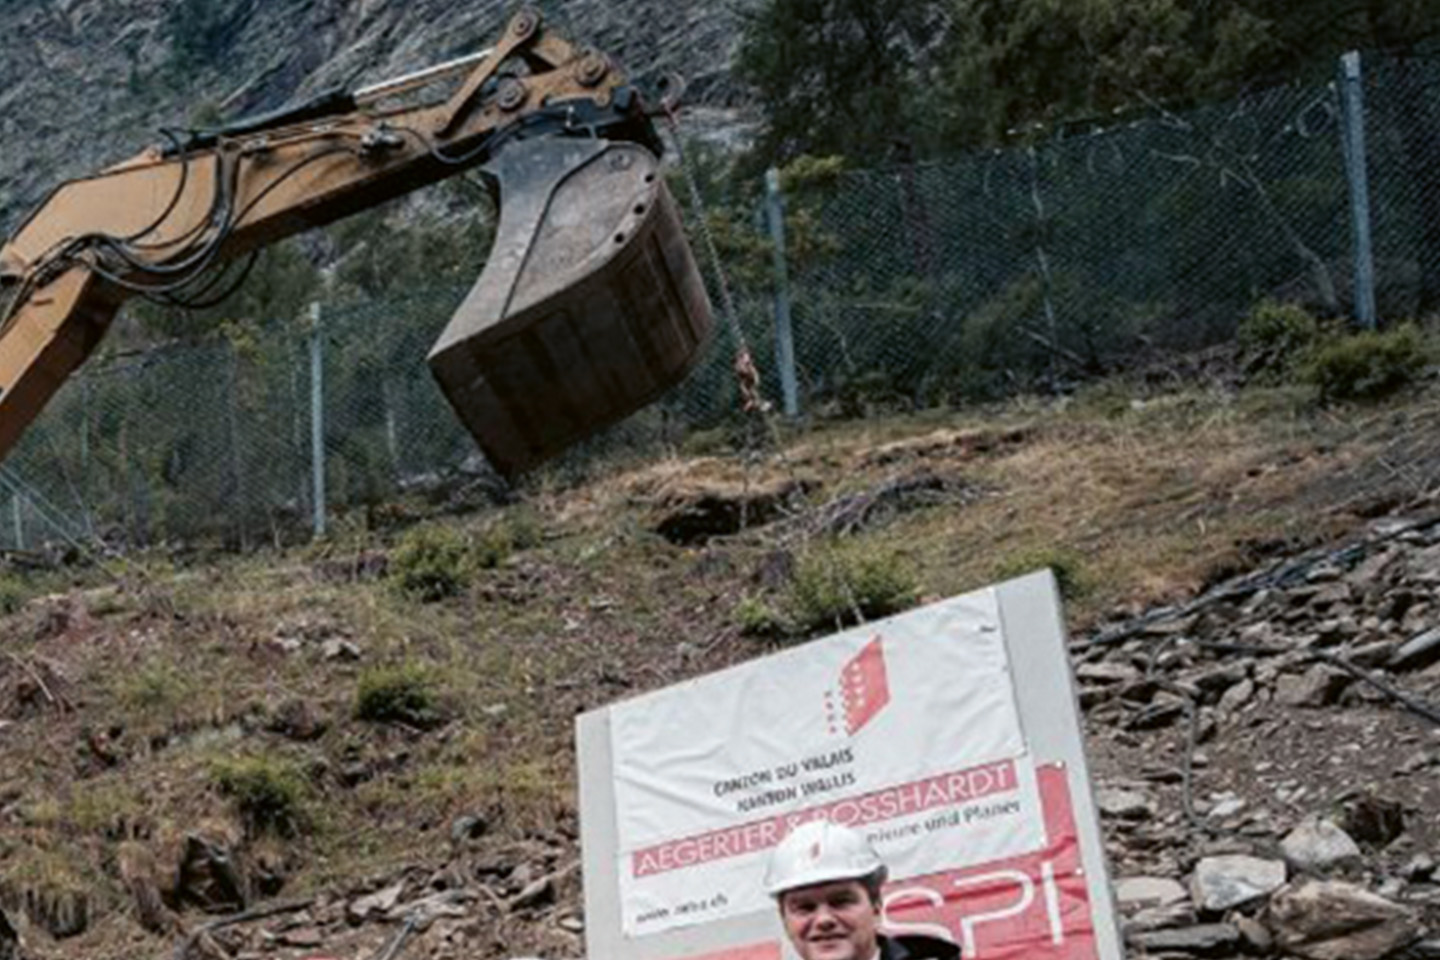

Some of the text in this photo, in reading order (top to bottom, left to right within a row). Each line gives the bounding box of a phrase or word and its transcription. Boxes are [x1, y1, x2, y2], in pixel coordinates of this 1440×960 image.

[713, 747, 854, 797] CANTON DU VALAIS
[737, 772, 856, 812] KANTON WALLIS
[866, 800, 1021, 843] nieure und Planer
[637, 822, 778, 875] AEGERTER
